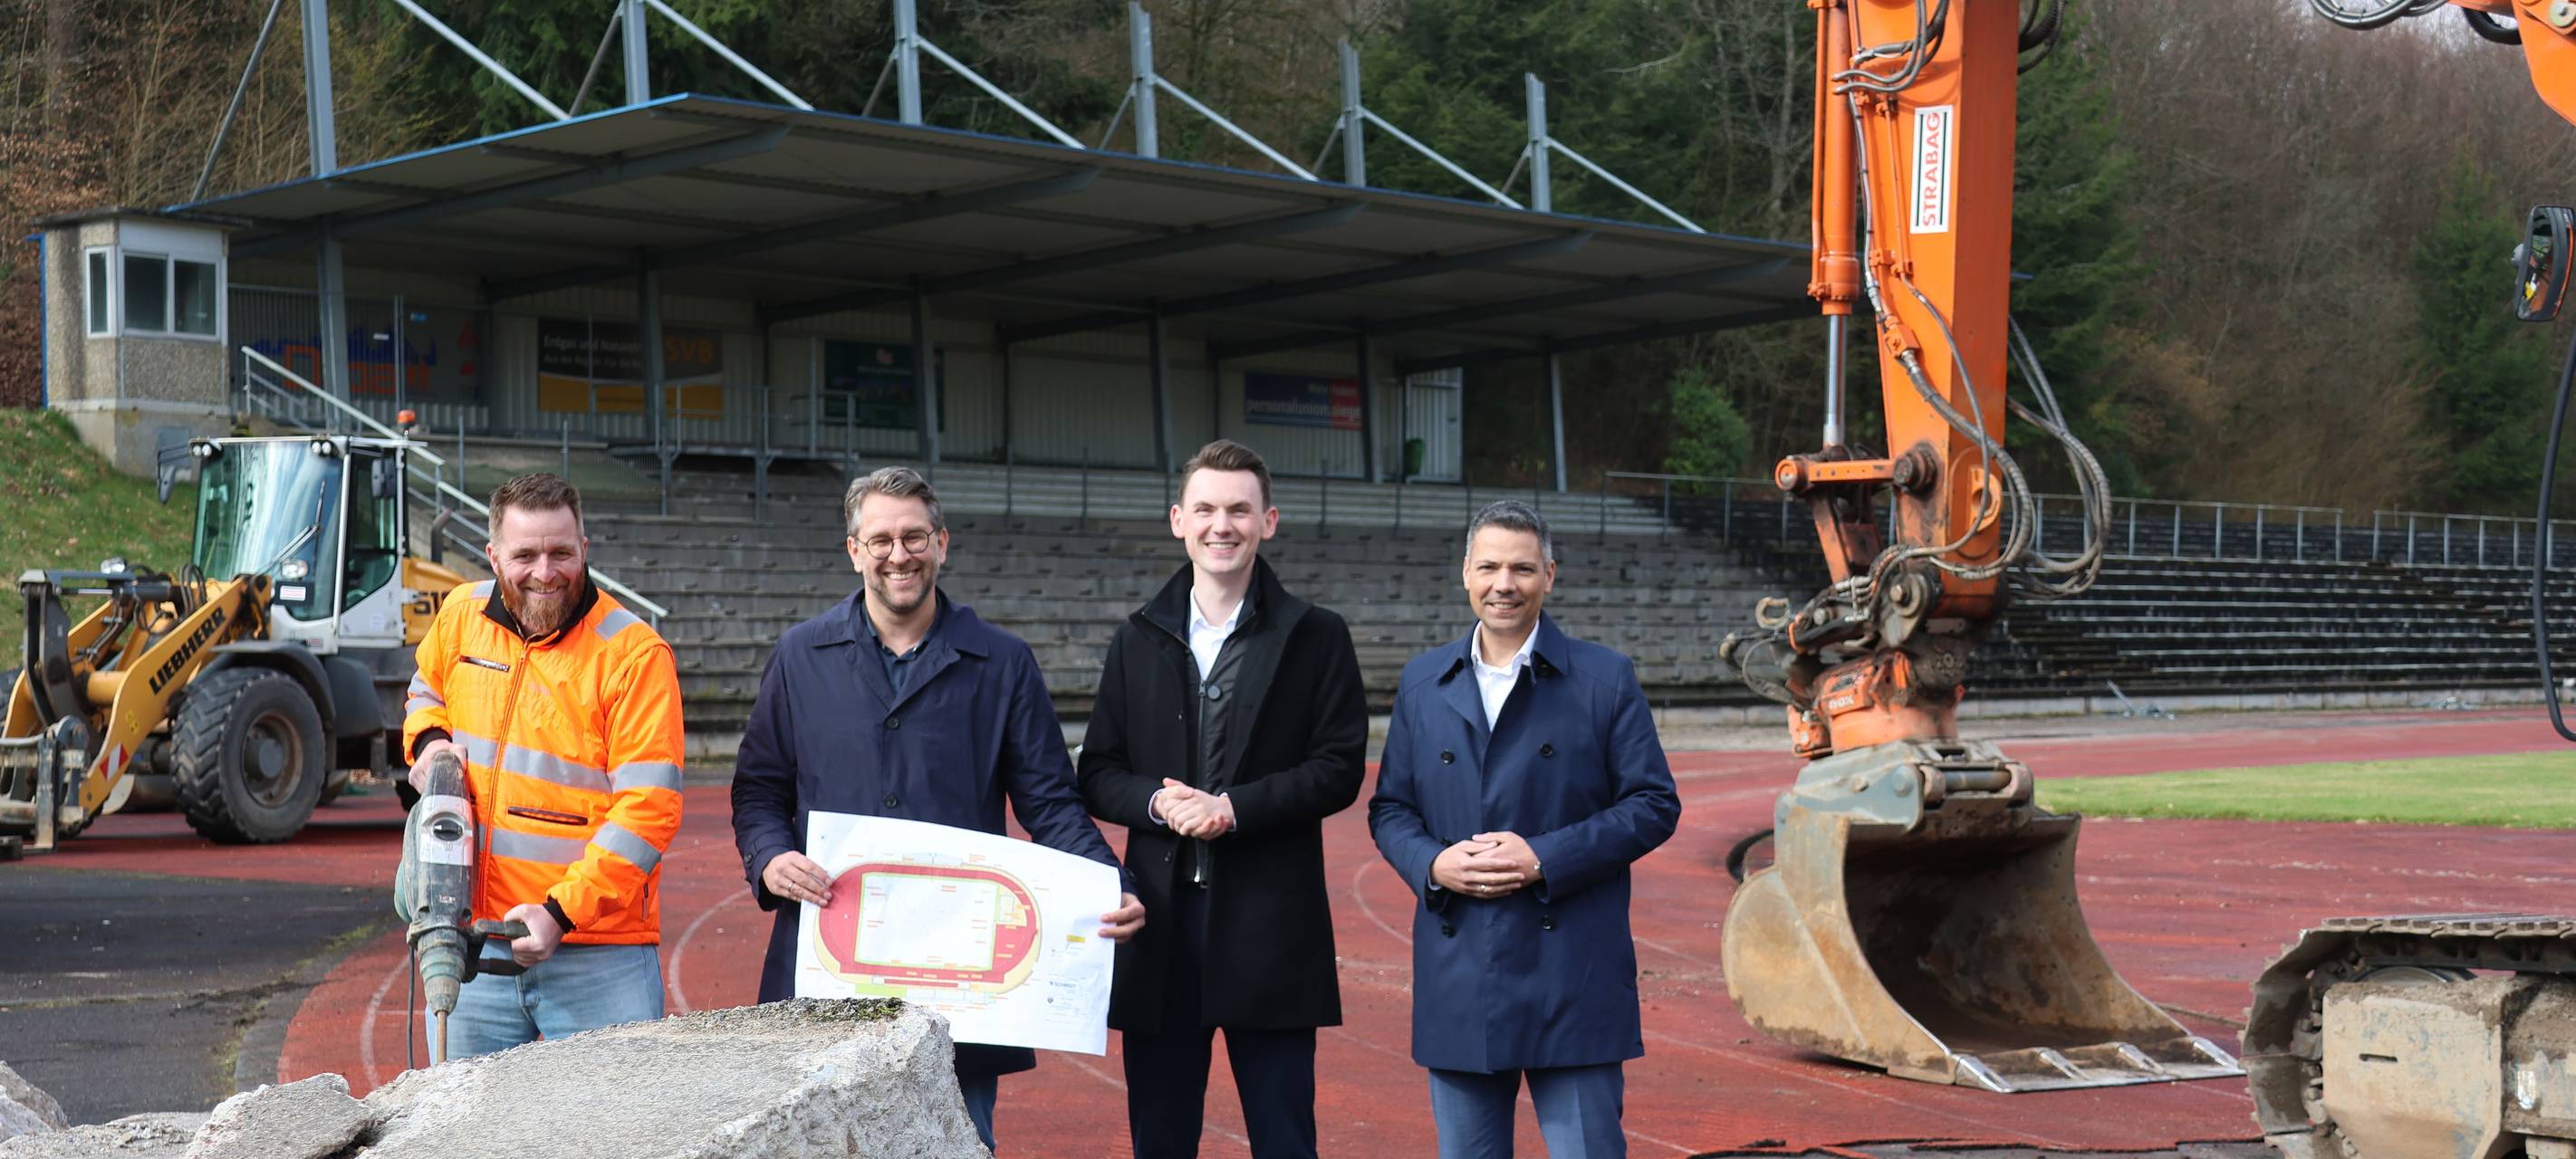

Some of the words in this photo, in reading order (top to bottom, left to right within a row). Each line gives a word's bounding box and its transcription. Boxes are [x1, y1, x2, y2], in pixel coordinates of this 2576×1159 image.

[1922, 111, 1940, 226] STRABAG
[667, 336, 714, 364] SVB
[413, 591, 449, 615] 51
[149, 607, 226, 695] LIEBHERR
